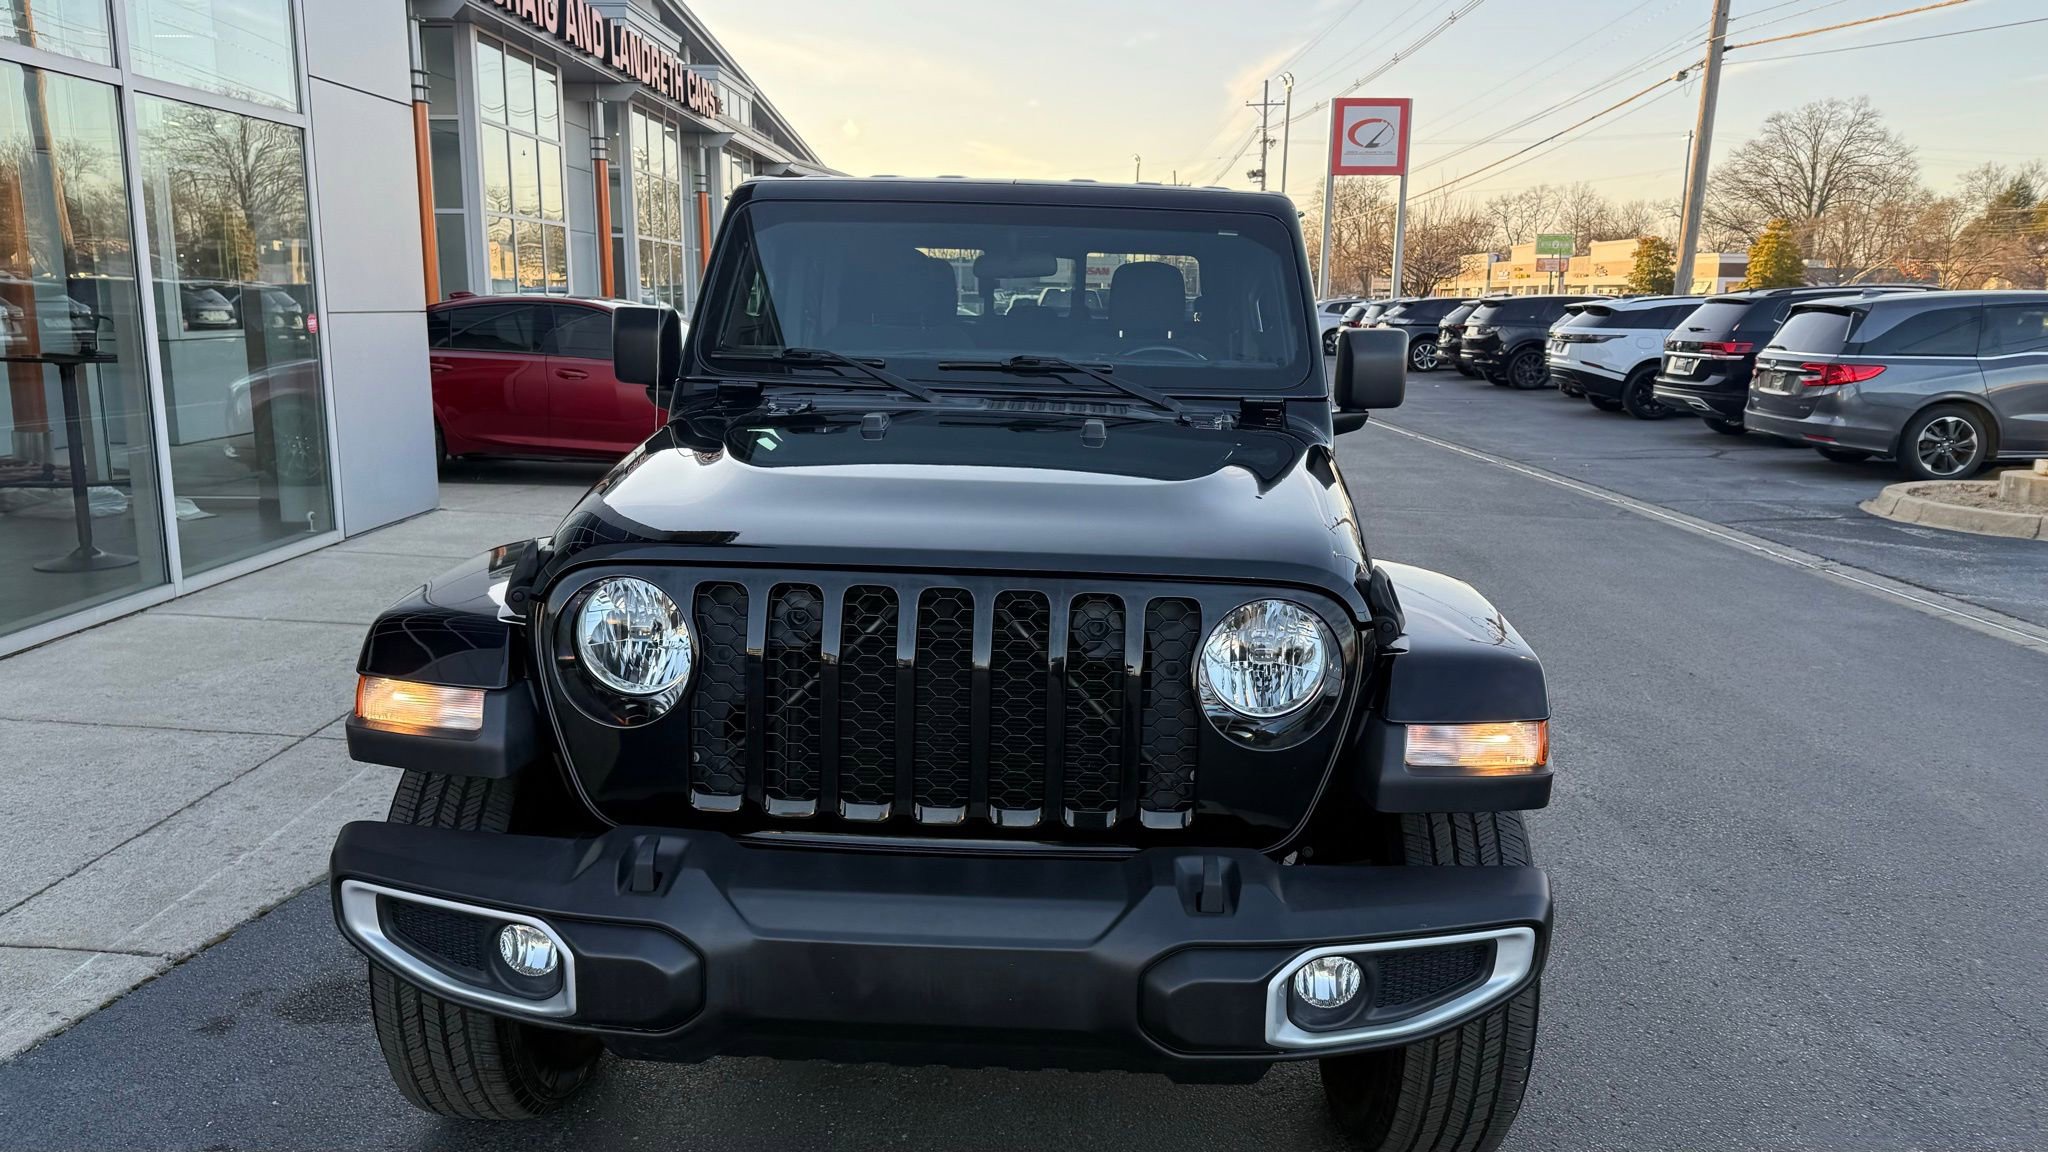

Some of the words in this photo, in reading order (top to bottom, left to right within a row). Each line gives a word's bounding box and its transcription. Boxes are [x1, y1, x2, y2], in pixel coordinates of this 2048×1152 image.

[566, 0, 605, 59] AND
[610, 18, 685, 104] LANDRETH
[687, 68, 716, 120] CARS
